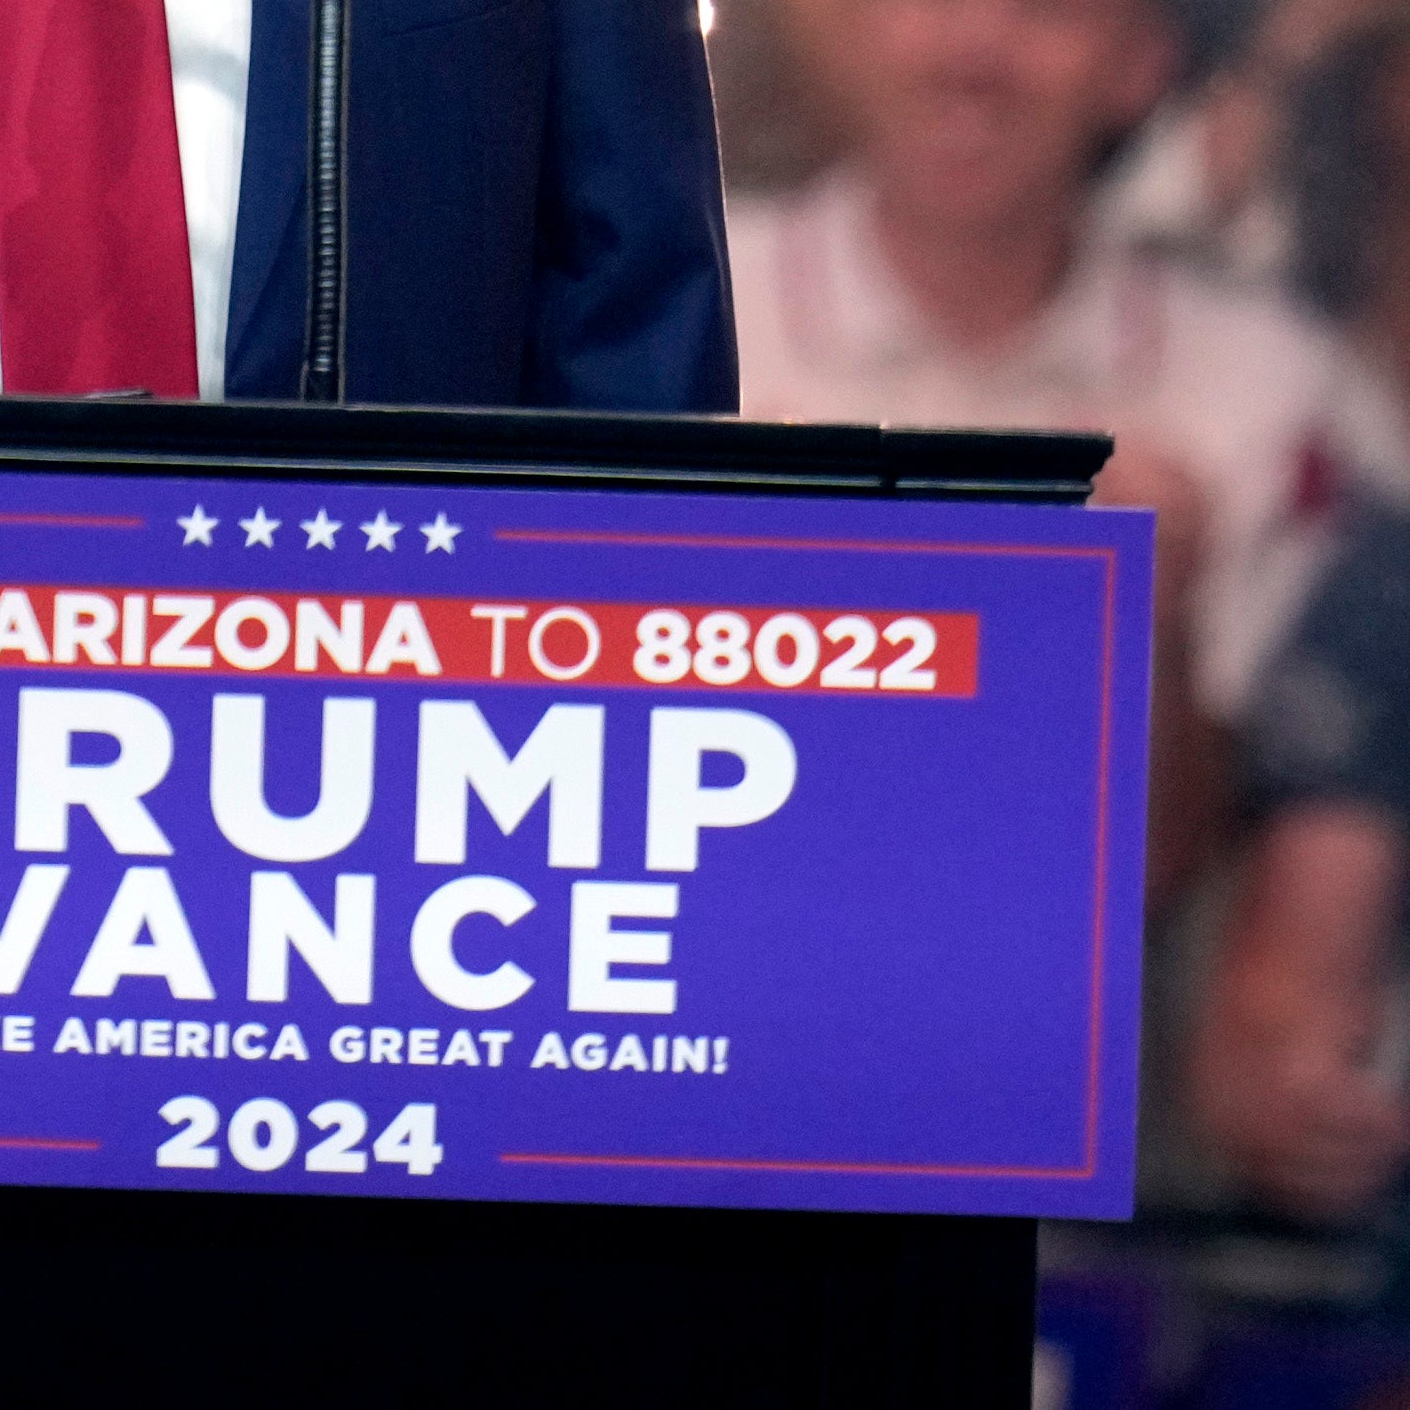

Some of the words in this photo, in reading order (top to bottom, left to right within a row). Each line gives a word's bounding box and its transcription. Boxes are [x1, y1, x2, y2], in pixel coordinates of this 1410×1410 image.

[470, 604, 602, 682] TO
[632, 609, 938, 692] 88022
[53, 1017, 309, 1061] AMERICA
[329, 1025, 513, 1068] GREAT
[530, 1031, 728, 1074] AGAIN!
[156, 1095, 444, 1176] 2024
